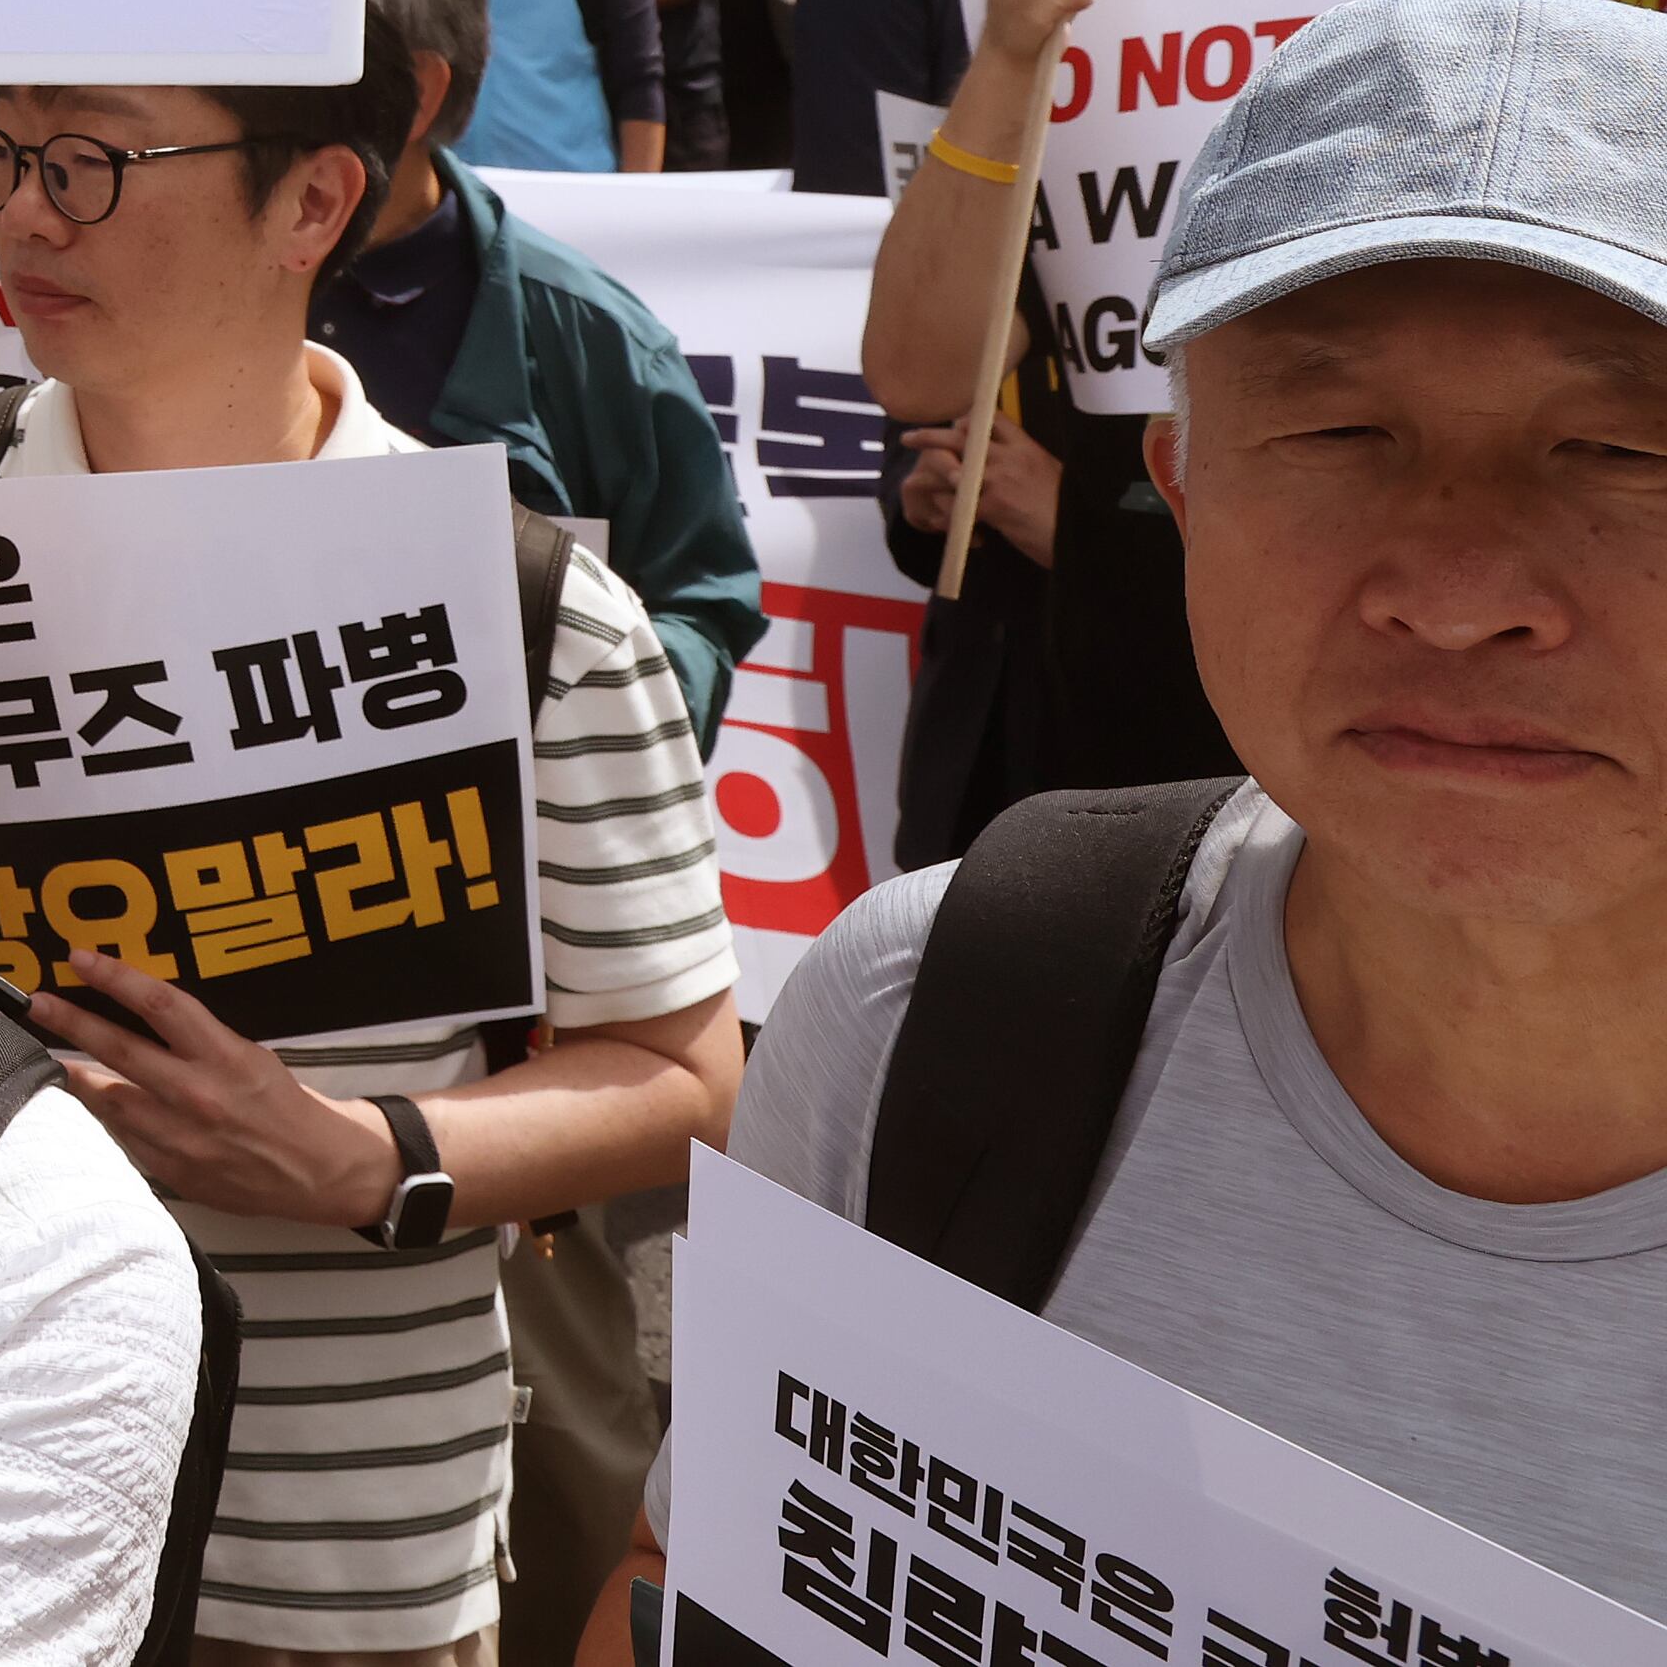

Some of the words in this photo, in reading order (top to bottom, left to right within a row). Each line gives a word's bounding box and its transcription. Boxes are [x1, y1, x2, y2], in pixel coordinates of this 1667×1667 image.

[213, 603, 467, 751] 파병
[774, 1369, 1175, 1663] 대한민국은
[778, 1479, 1107, 1667] 침략
[1323, 1567, 1511, 1667] 헌
